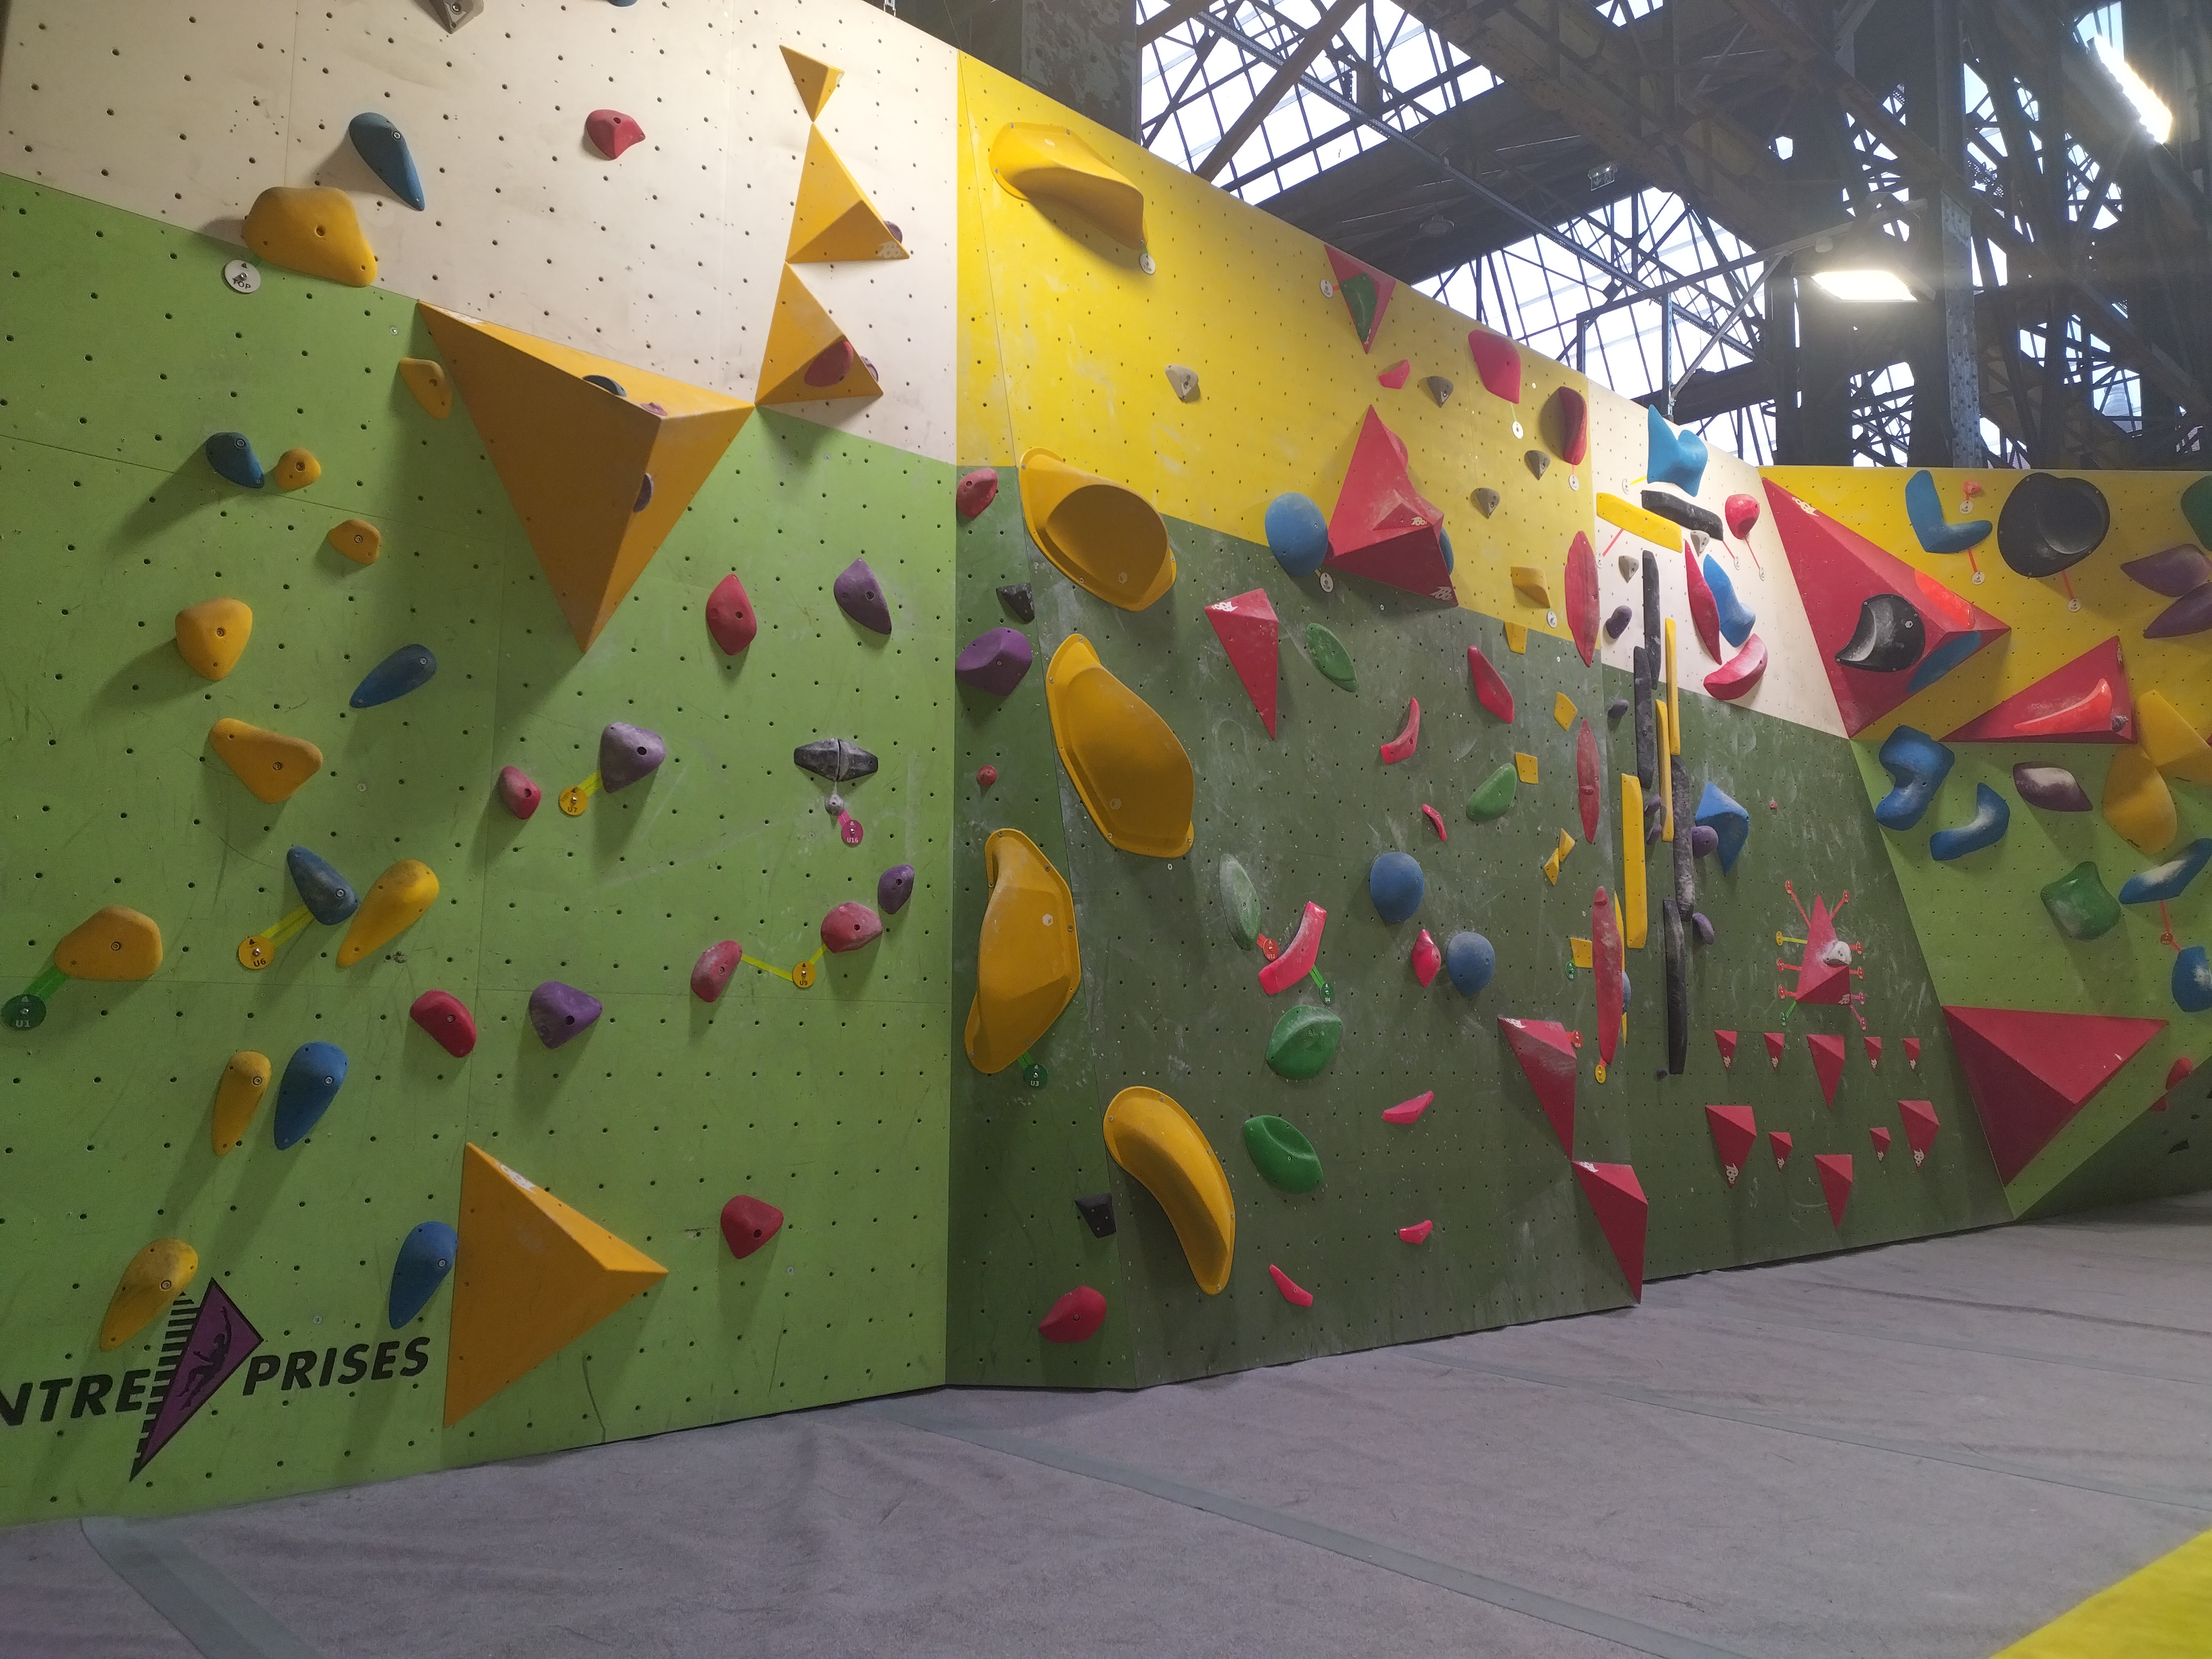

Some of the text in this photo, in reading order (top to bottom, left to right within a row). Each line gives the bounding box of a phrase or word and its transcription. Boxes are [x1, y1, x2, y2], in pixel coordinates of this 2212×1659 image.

[232, 278, 251, 289] TOP
[253, 958, 266, 967] U6
[0, 1337, 430, 1426] NTRE PRISES
